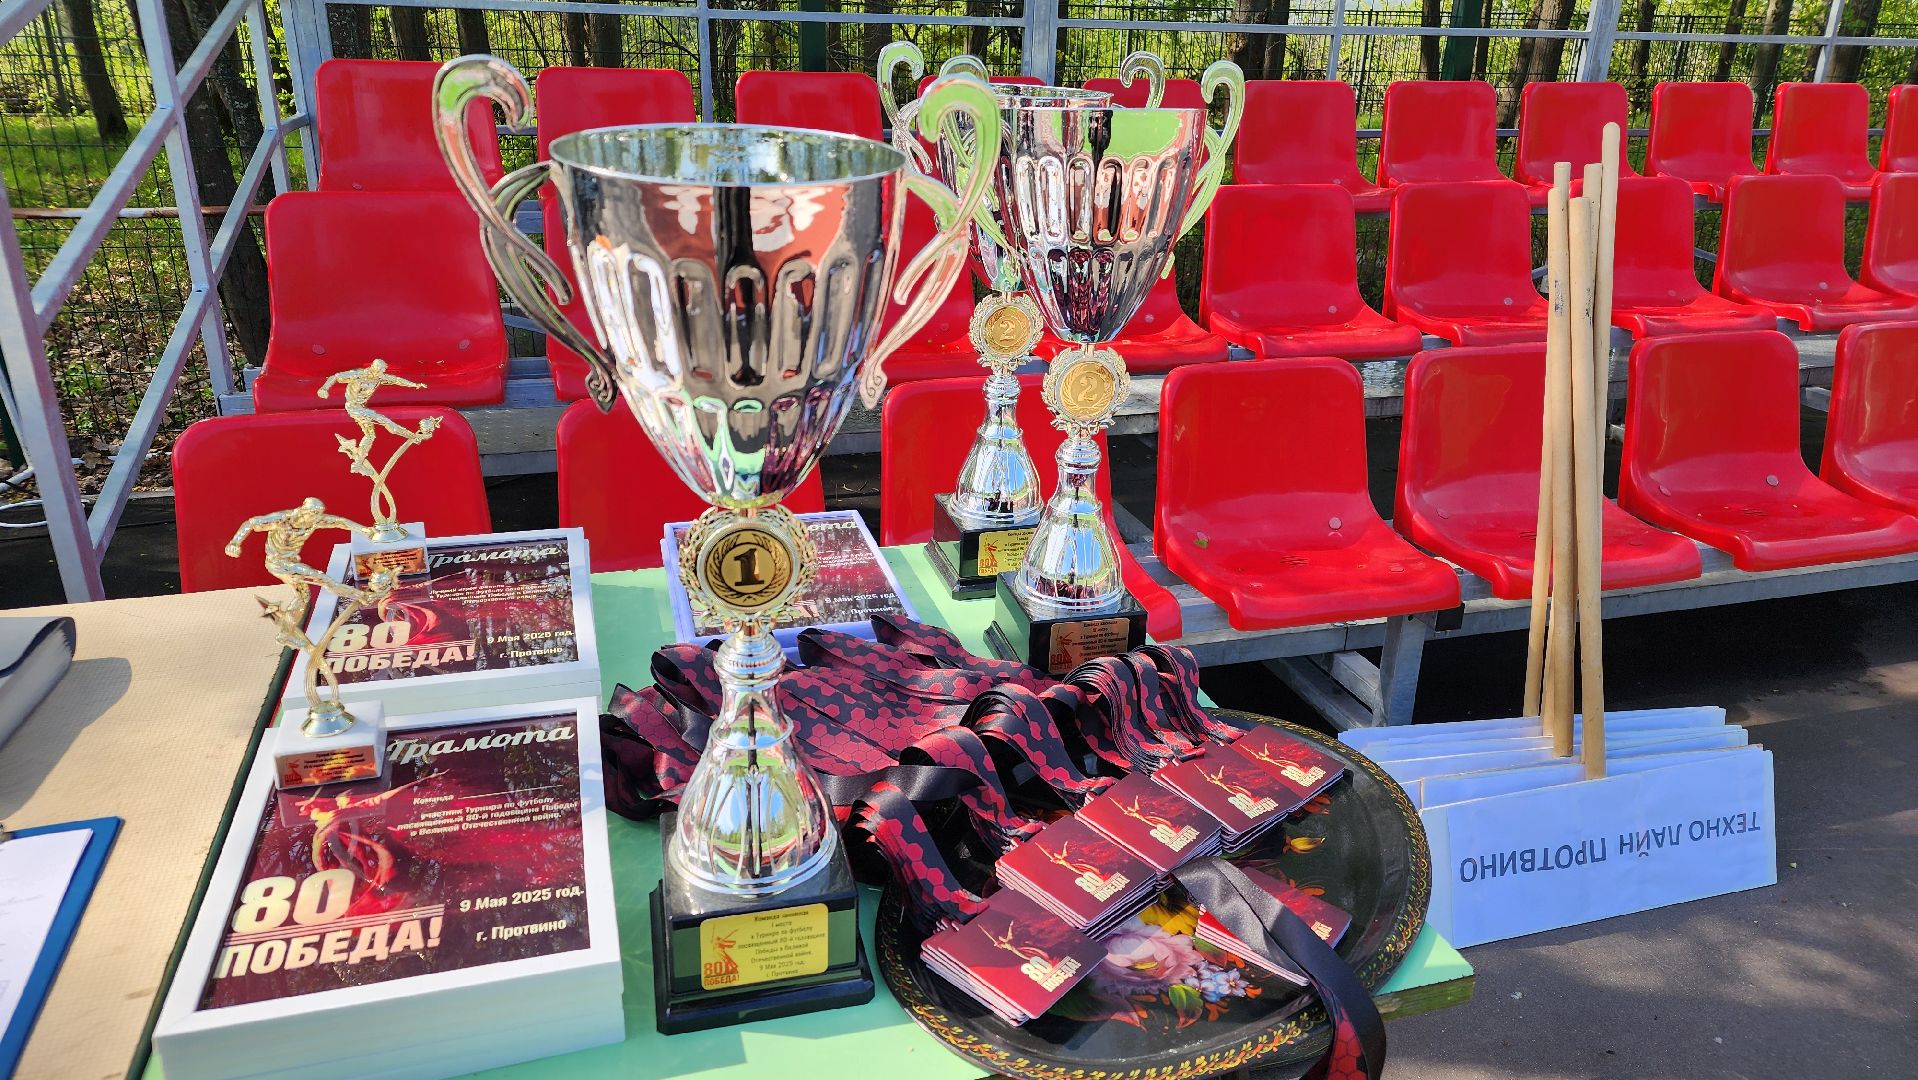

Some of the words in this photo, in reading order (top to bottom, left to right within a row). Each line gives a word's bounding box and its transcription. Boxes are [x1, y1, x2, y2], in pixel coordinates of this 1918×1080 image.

[1000, 320, 1016, 342] 2
[1077, 373, 1099, 402] 2
[427, 547, 561, 569] Грамота
[734, 548, 765, 587] 1
[327, 620, 411, 653] 80
[487, 636, 495, 644] 9
[498, 635, 521, 643] Мая
[320, 643, 476, 675] ПОБЕДА!
[511, 647, 563, 658] Протвино
[387, 726, 576, 765] Грамота
[413, 794, 455, 806] Команда
[466, 811, 489, 822] 80-й
[490, 806, 540, 819] годовщине
[541, 800, 578, 812] Победы
[504, 801, 515, 809] по
[517, 796, 555, 808] футболу
[419, 824, 460, 836] Великой
[461, 815, 531, 831] Отечественной
[1150, 823, 1178, 846] 80
[1689, 811, 1761, 842] ТЕХНО
[1619, 823, 1683, 858] ЛАЙН
[1460, 837, 1607, 883] ПРОТВИНО
[1075, 871, 1105, 894] 80
[232, 868, 356, 934] 80
[460, 899, 471, 912] 9
[473, 896, 508, 911] Мая
[512, 887, 552, 905] 2025
[555, 885, 585, 898] год.
[476, 930, 488, 942] г.
[491, 919, 568, 941] Протвино
[213, 915, 444, 979] ПОБЕДА!
[703, 973, 740, 987] ПОБЕДА!
[704, 961, 723, 977] 80
[1021, 955, 1053, 982] 80
